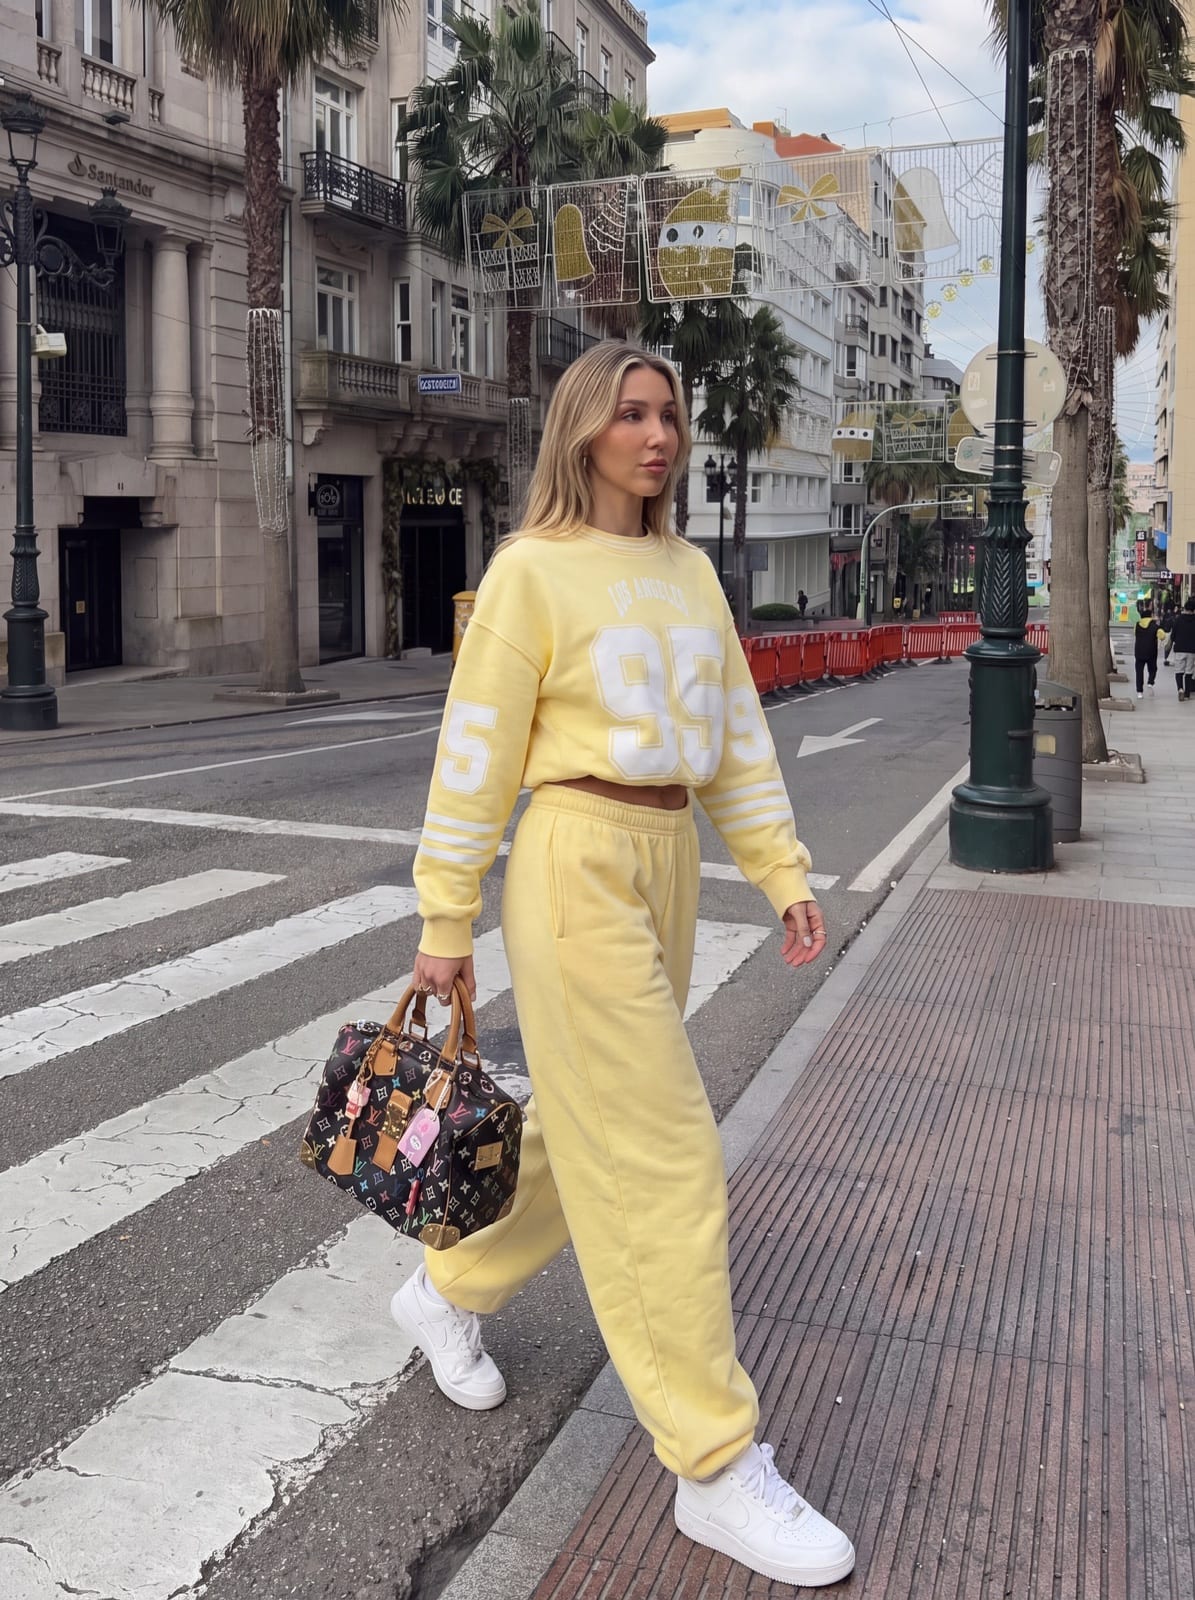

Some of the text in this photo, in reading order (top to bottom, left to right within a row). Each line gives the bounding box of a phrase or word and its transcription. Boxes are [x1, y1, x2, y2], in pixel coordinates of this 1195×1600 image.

[87, 164, 155, 198] Santander
[607, 576, 689, 617] LOS ANGELES
[591, 624, 725, 781] 95
[727, 686, 772, 762] 9
[440, 699, 499, 795] 5
